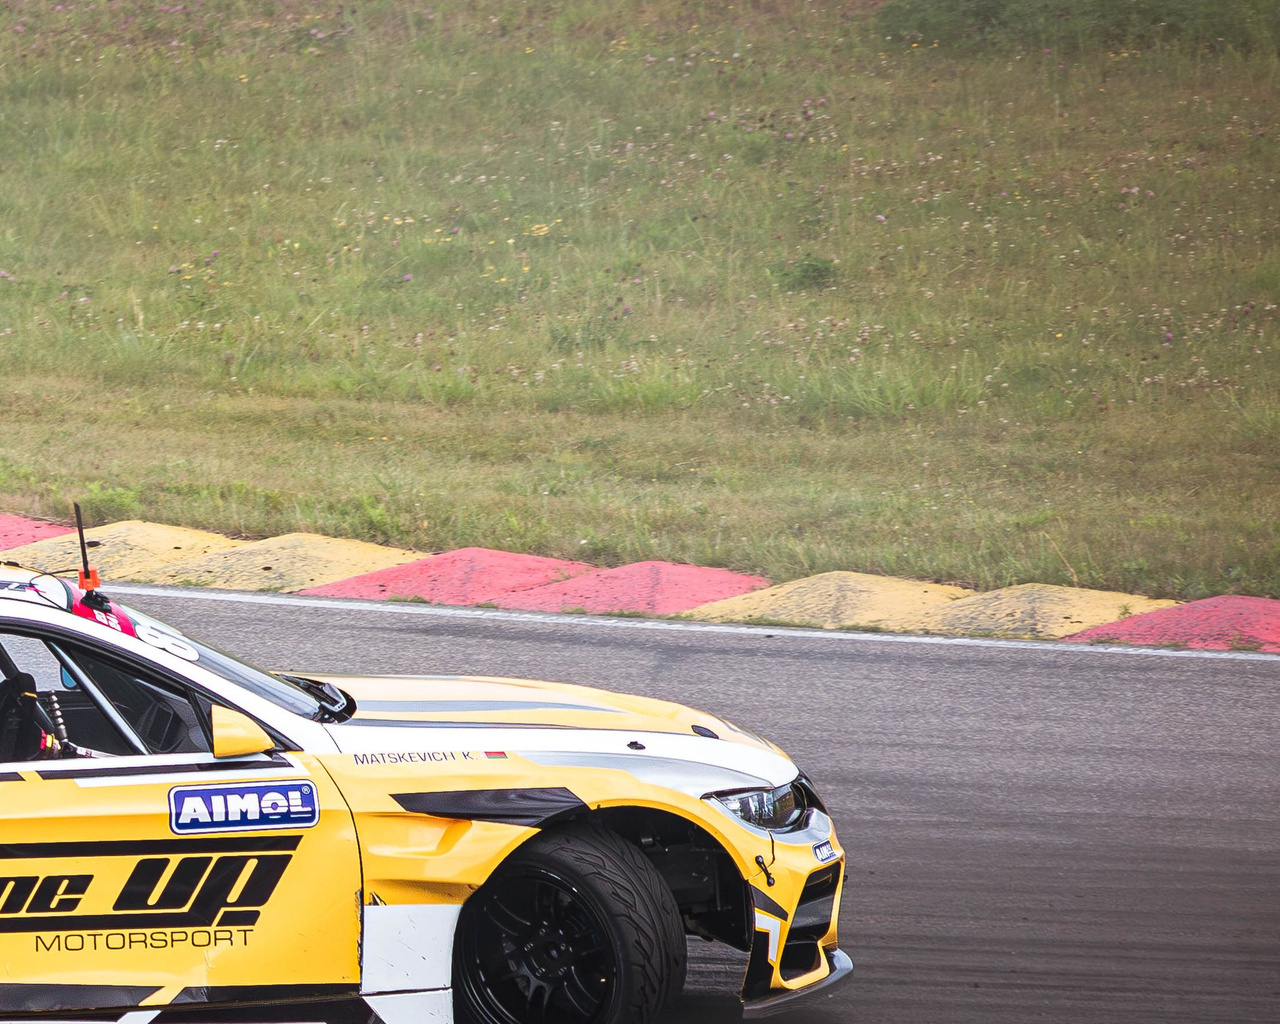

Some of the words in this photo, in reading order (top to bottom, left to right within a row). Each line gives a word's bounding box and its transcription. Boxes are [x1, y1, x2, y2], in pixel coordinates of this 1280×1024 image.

[353, 751, 456, 766] MATSKEVICH
[178, 790, 313, 824] AIMOL
[34, 929, 255, 953] MOTORSPORT
